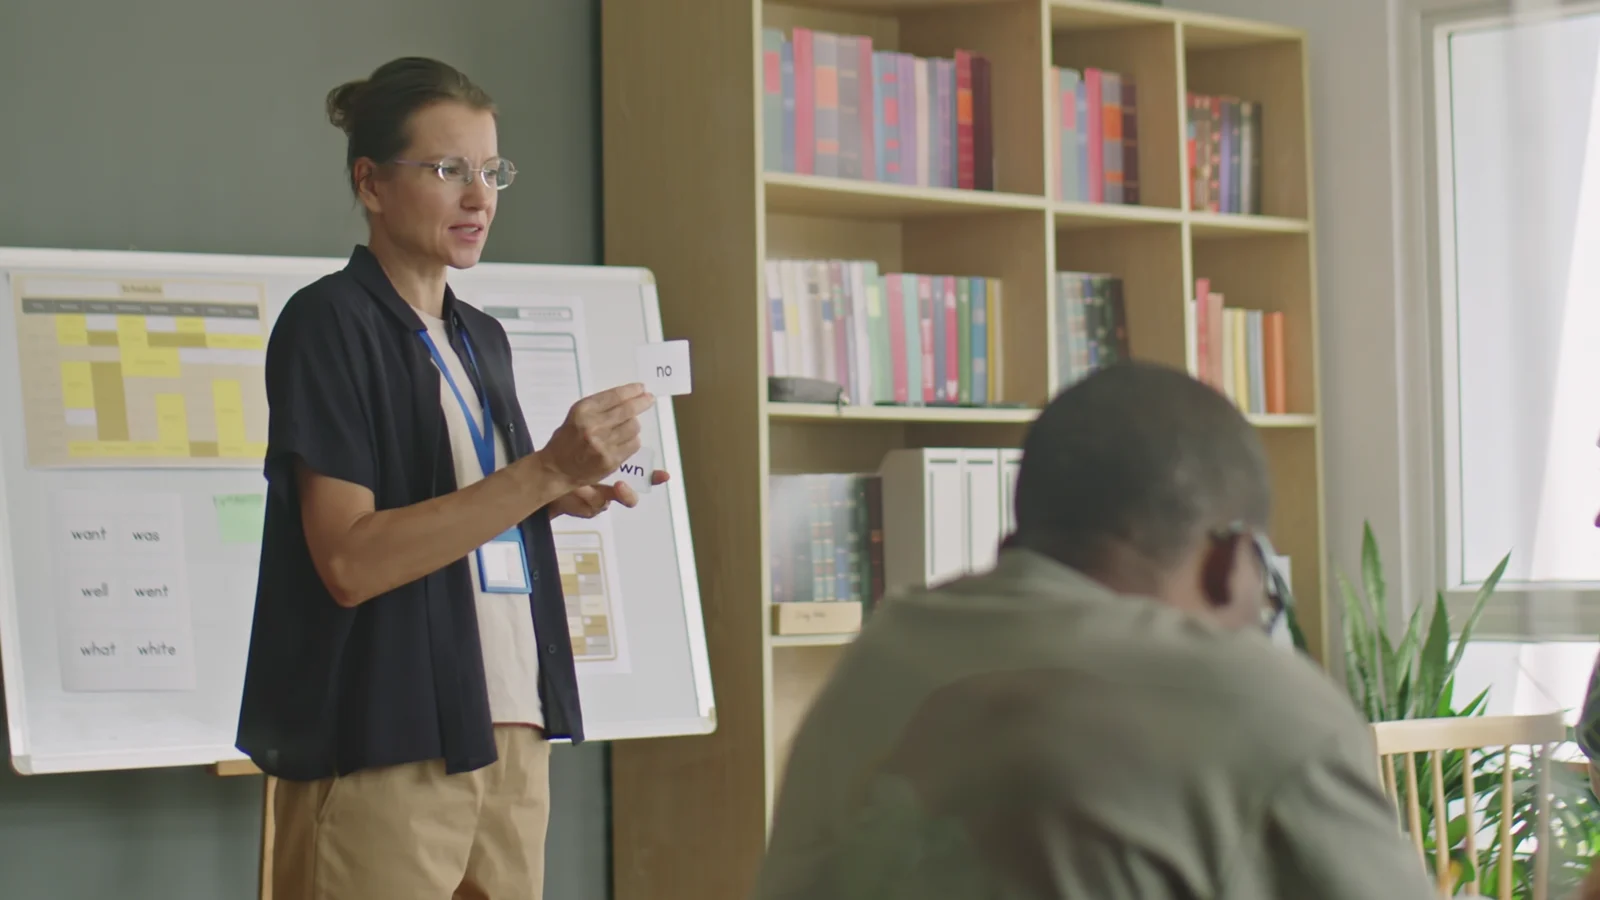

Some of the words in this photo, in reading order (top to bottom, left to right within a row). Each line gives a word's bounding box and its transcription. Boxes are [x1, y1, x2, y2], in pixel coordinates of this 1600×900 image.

[656, 365, 672, 377] no
[619, 463, 644, 477] wn
[71, 526, 107, 541] want
[132, 530, 160, 542] was
[81, 582, 108, 597] well
[134, 584, 169, 597] went
[80, 641, 116, 656] what
[137, 640, 176, 656] white
